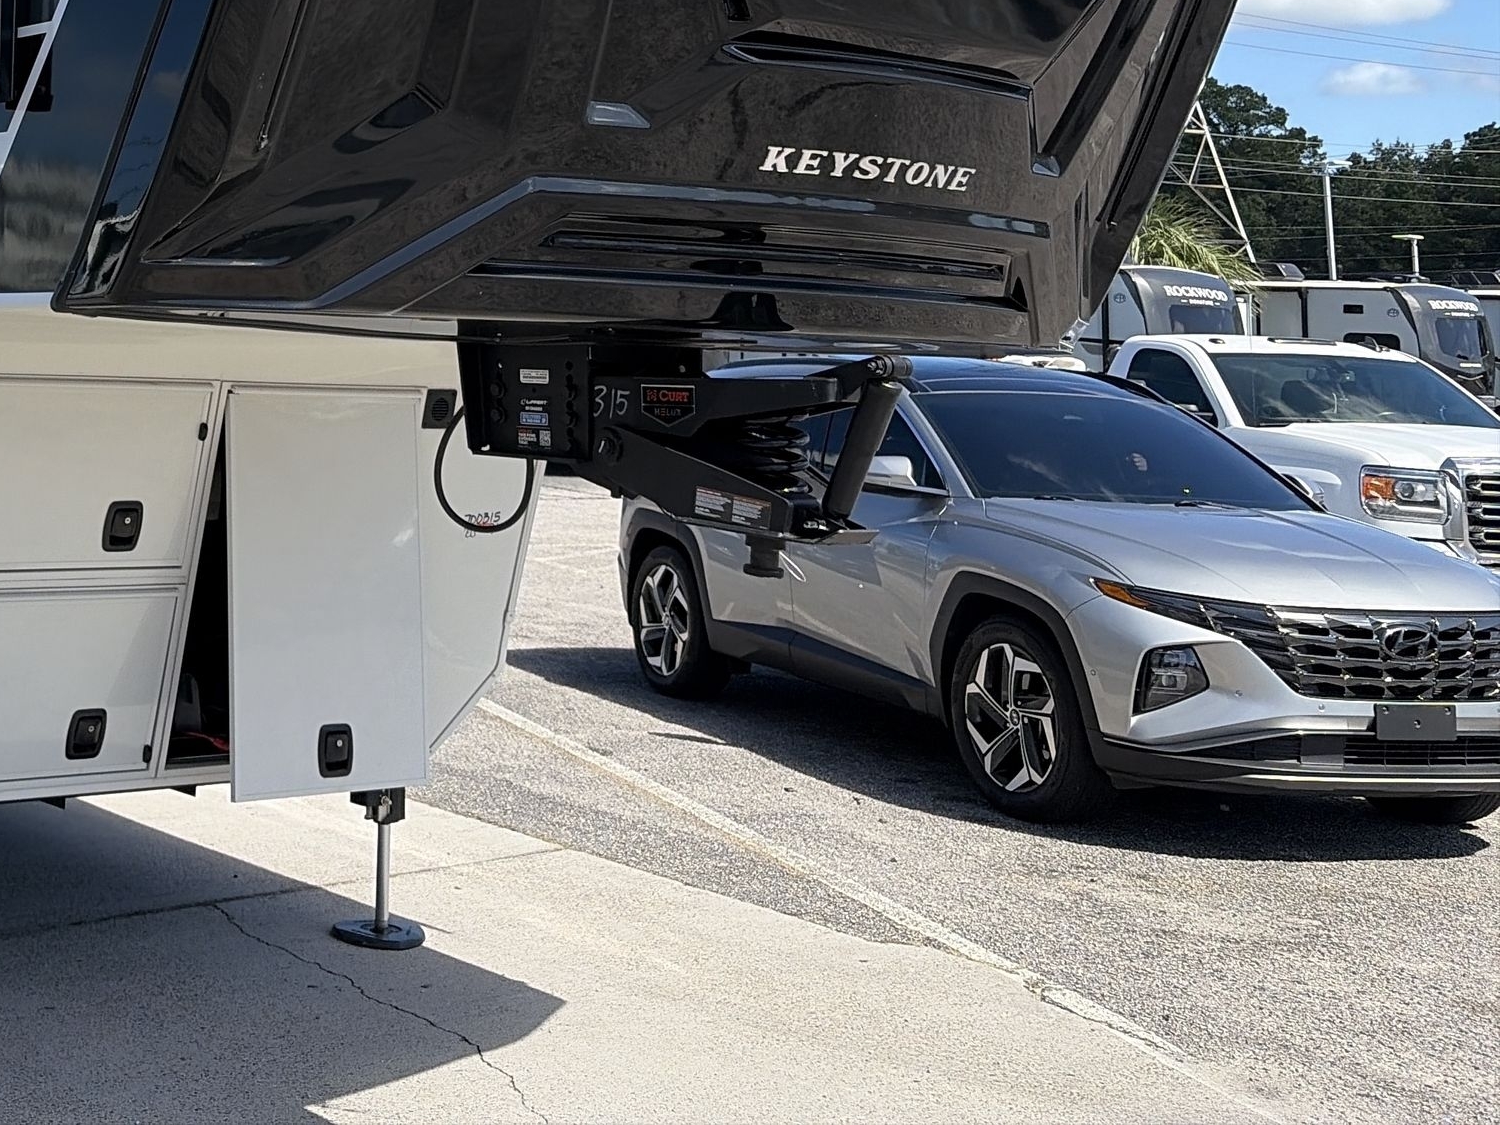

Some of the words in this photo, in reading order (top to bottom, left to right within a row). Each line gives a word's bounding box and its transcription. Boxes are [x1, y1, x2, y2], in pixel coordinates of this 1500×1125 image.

[759, 146, 976, 192] KEYSTONE
[1163, 285, 1228, 302] ROCKWOOD
[1428, 300, 1479, 312] ROCKWOOD
[593, 385, 630, 419] 315
[659, 390, 689, 402] CURT
